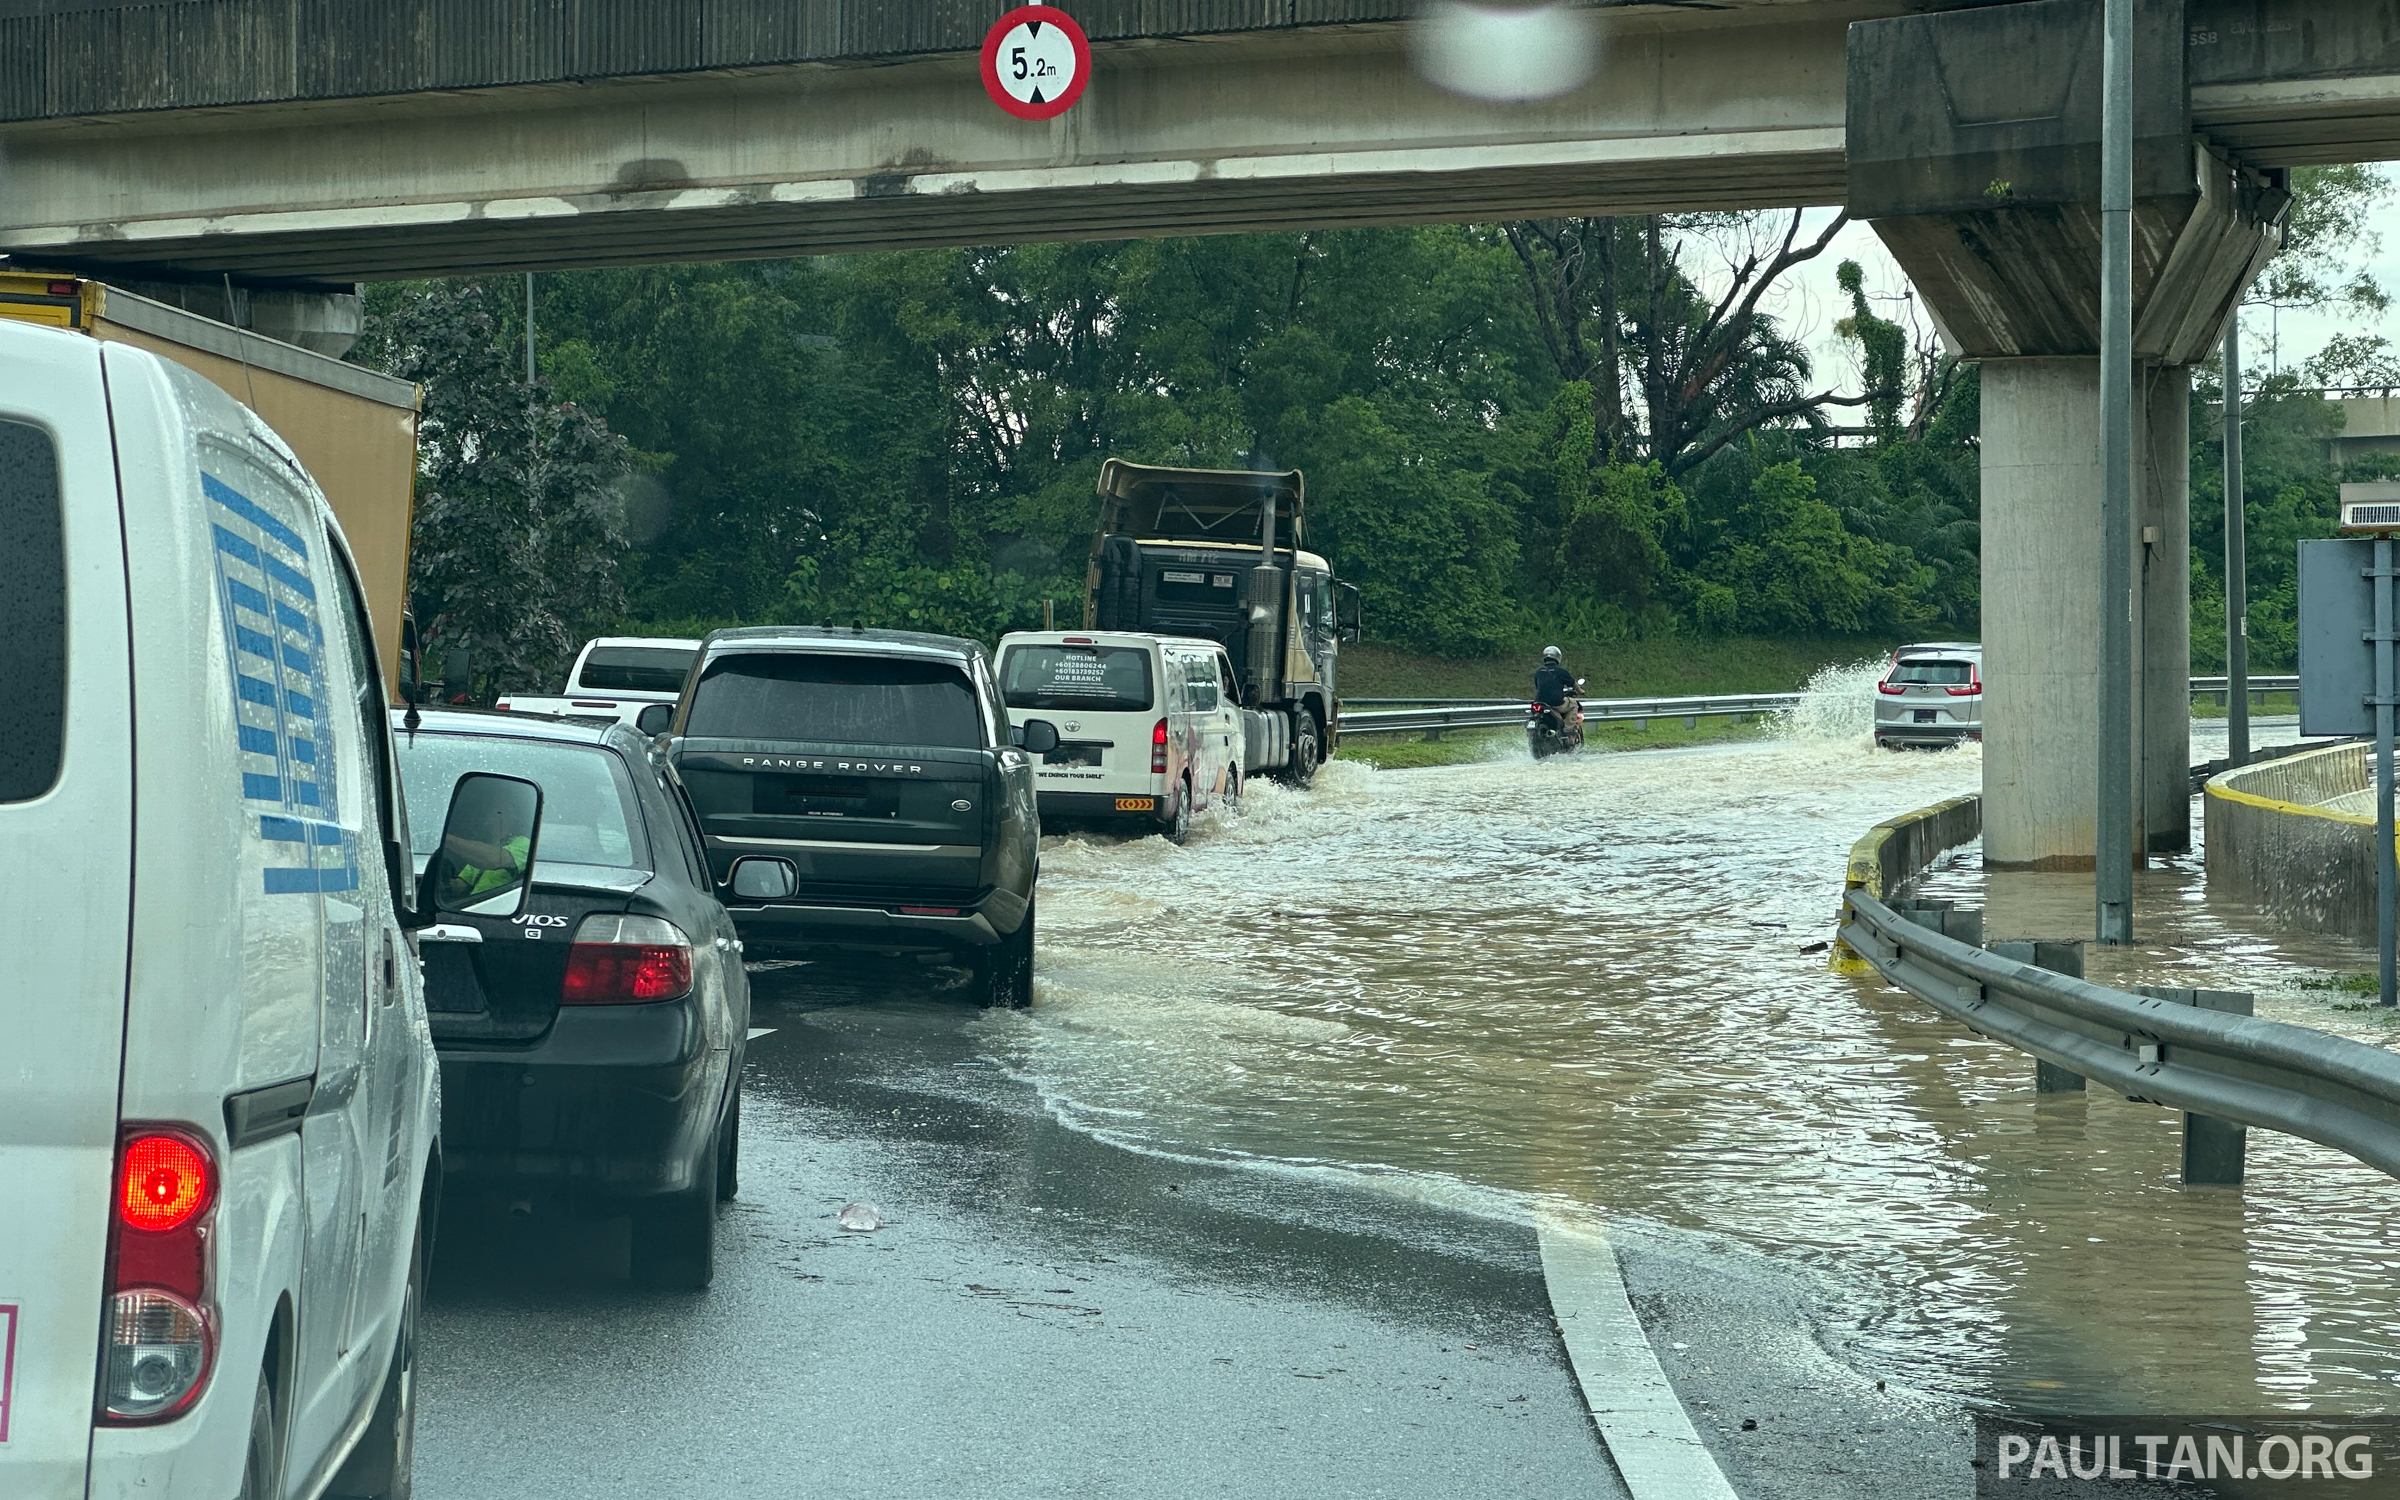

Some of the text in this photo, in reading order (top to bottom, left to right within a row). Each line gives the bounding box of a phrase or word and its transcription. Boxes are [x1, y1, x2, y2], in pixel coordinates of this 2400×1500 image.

[1011, 47, 1057, 80] 5.2m
[743, 757, 922, 774] RANGE ROVER
[511, 913, 569, 928] VIOS
[526, 929, 541, 939] G
